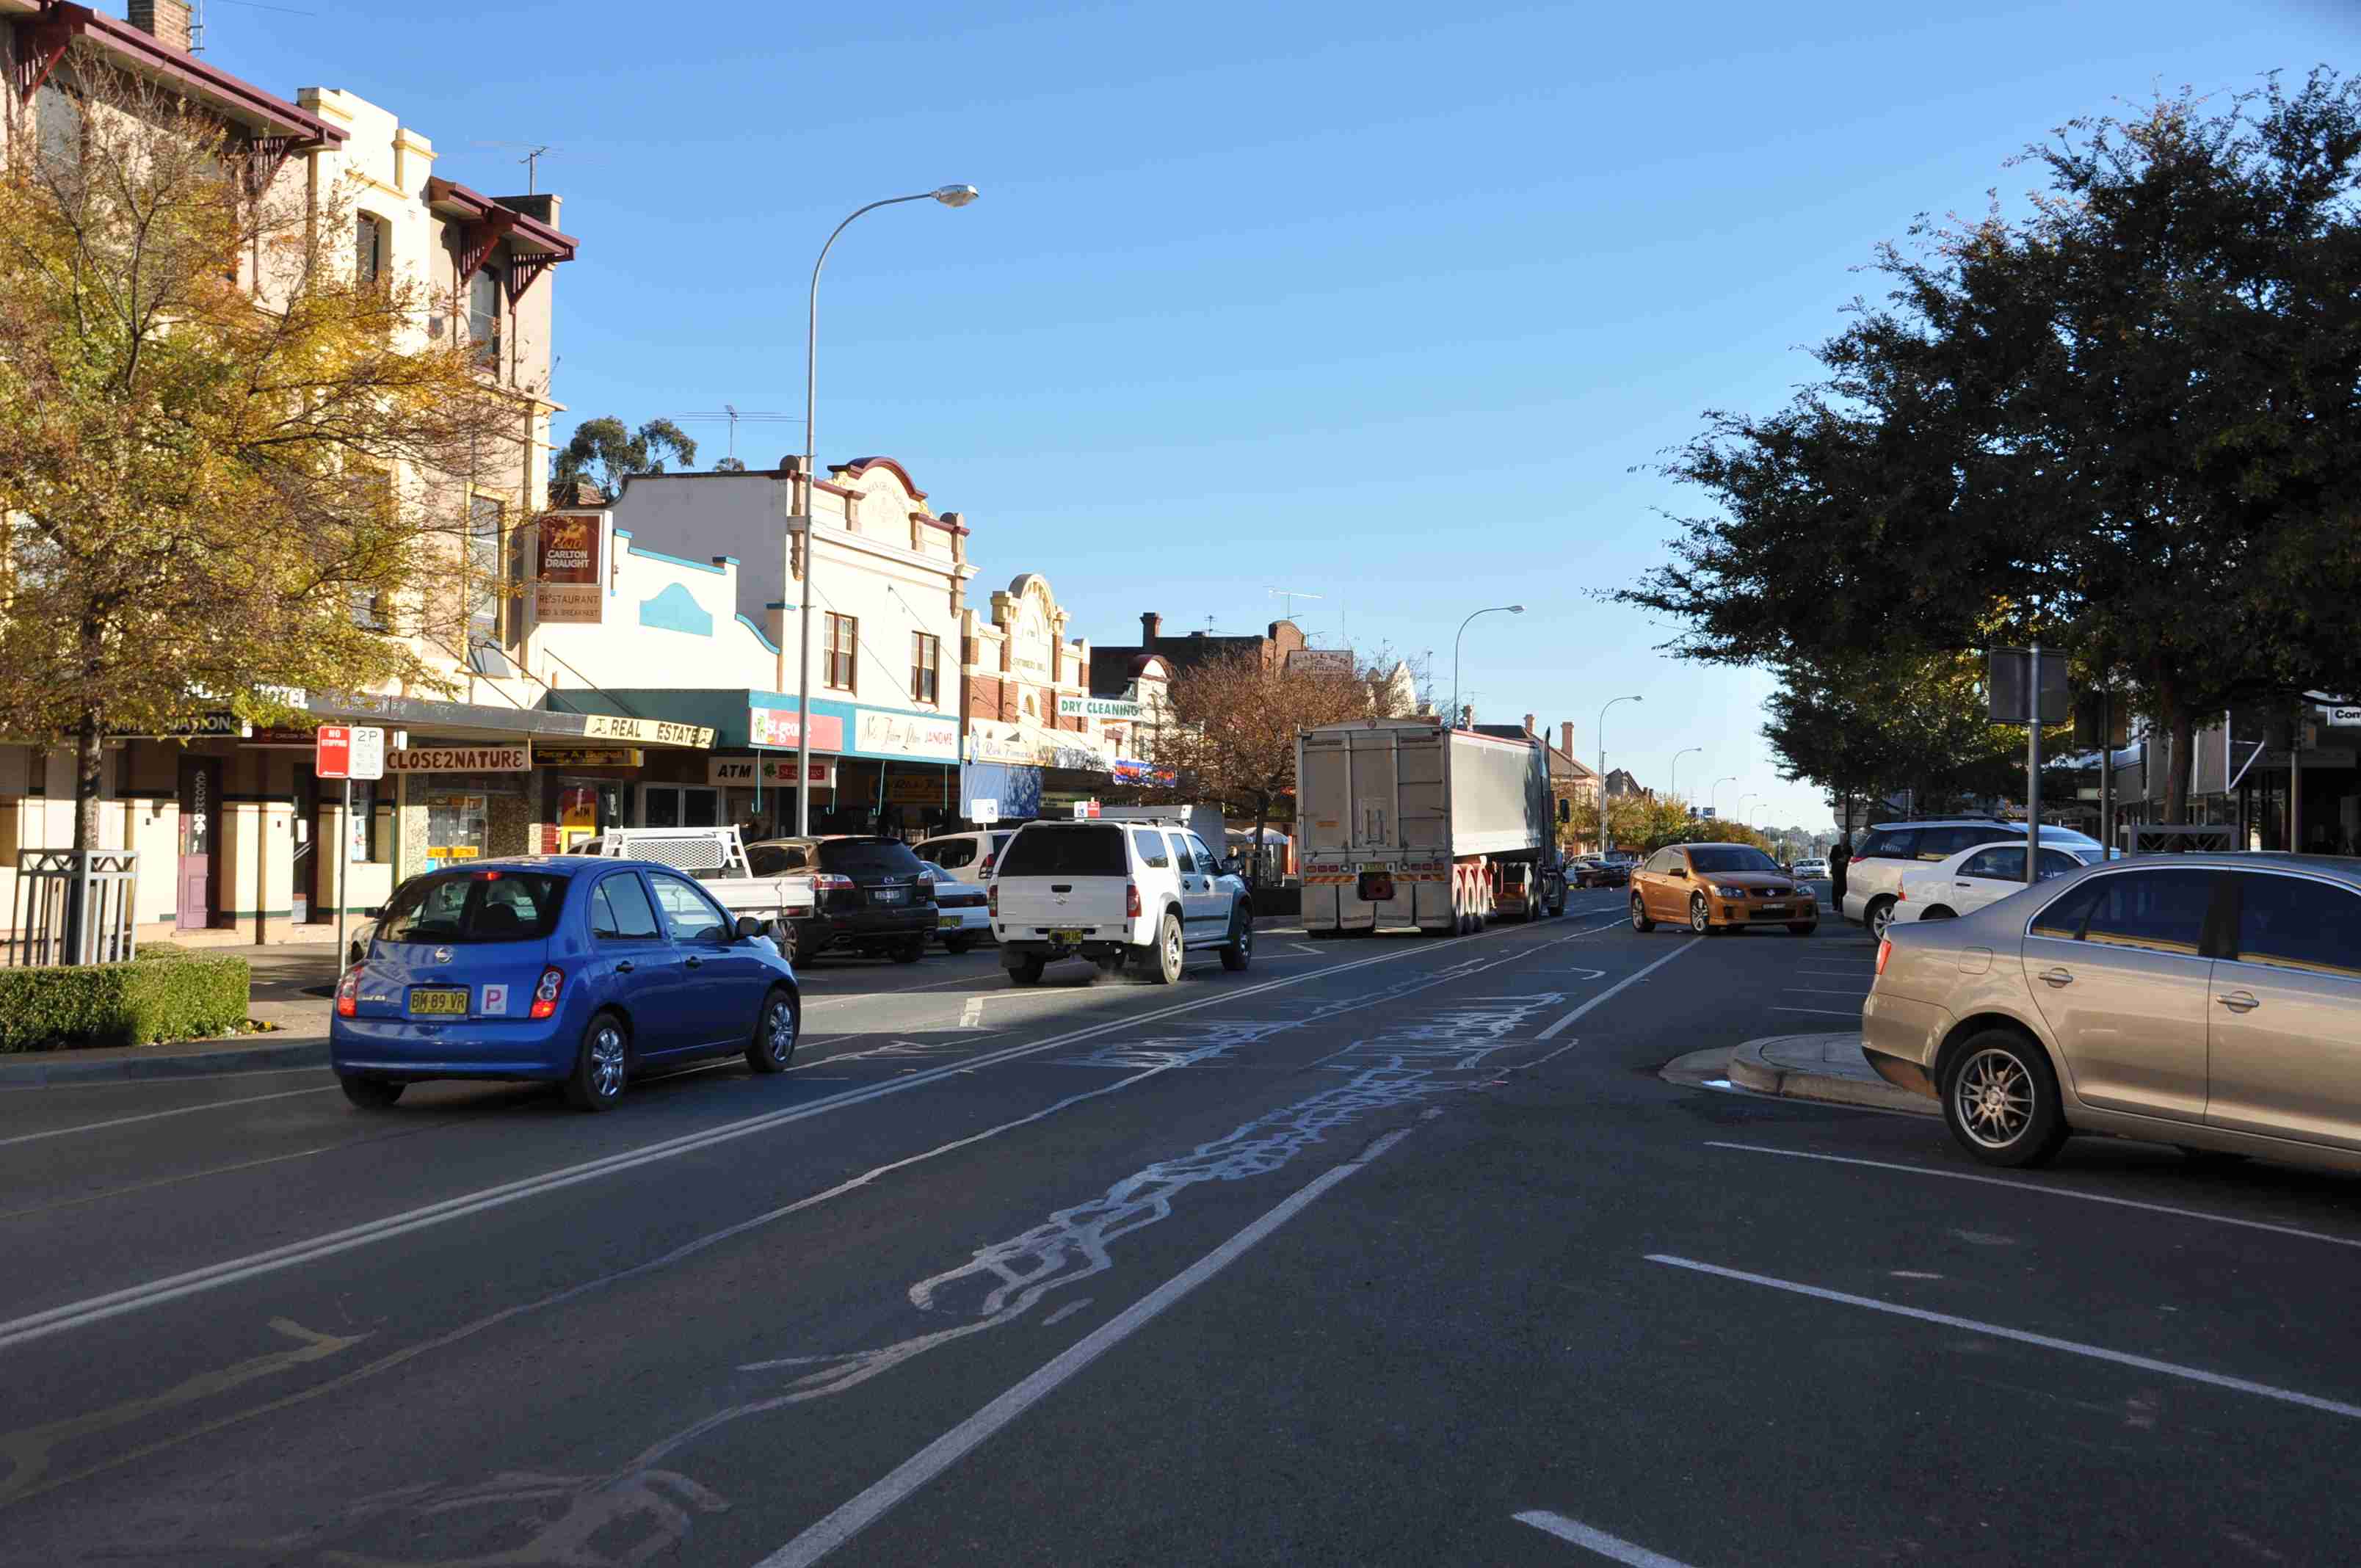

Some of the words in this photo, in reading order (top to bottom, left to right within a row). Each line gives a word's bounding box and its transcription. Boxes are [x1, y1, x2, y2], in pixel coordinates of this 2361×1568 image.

[547, 551, 588, 559] CARLTON
[545, 559, 590, 568] DRAUGHT
[539, 594, 599, 605] RESTAURANT
[1061, 700, 1081, 713] DRY
[1087, 702, 1139, 716] CLEANING
[328, 730, 341, 738] NO
[358, 730, 377, 742] 2P
[610, 719, 641, 738] REAL
[656, 722, 698, 744] ESTATE
[387, 750, 523, 769] CLOSE2NATURE
[717, 764, 752, 778] ATM
[485, 990, 501, 1010] P
